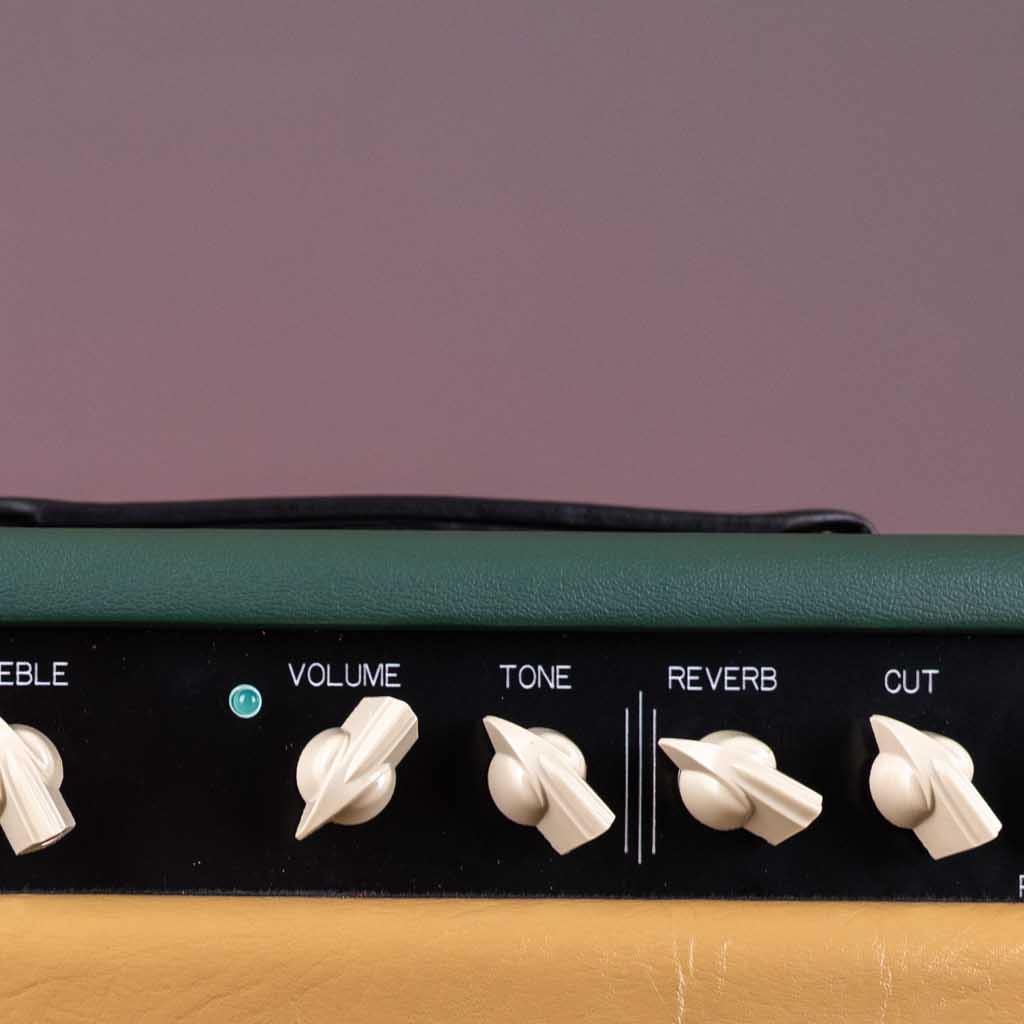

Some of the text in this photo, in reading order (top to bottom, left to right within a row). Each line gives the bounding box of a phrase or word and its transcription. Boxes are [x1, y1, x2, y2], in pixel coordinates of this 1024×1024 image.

[288, 662, 401, 688] VOLUME
[499, 664, 572, 690] TONE
[668, 665, 778, 692] REVERB
[884, 668, 940, 695] CUT
